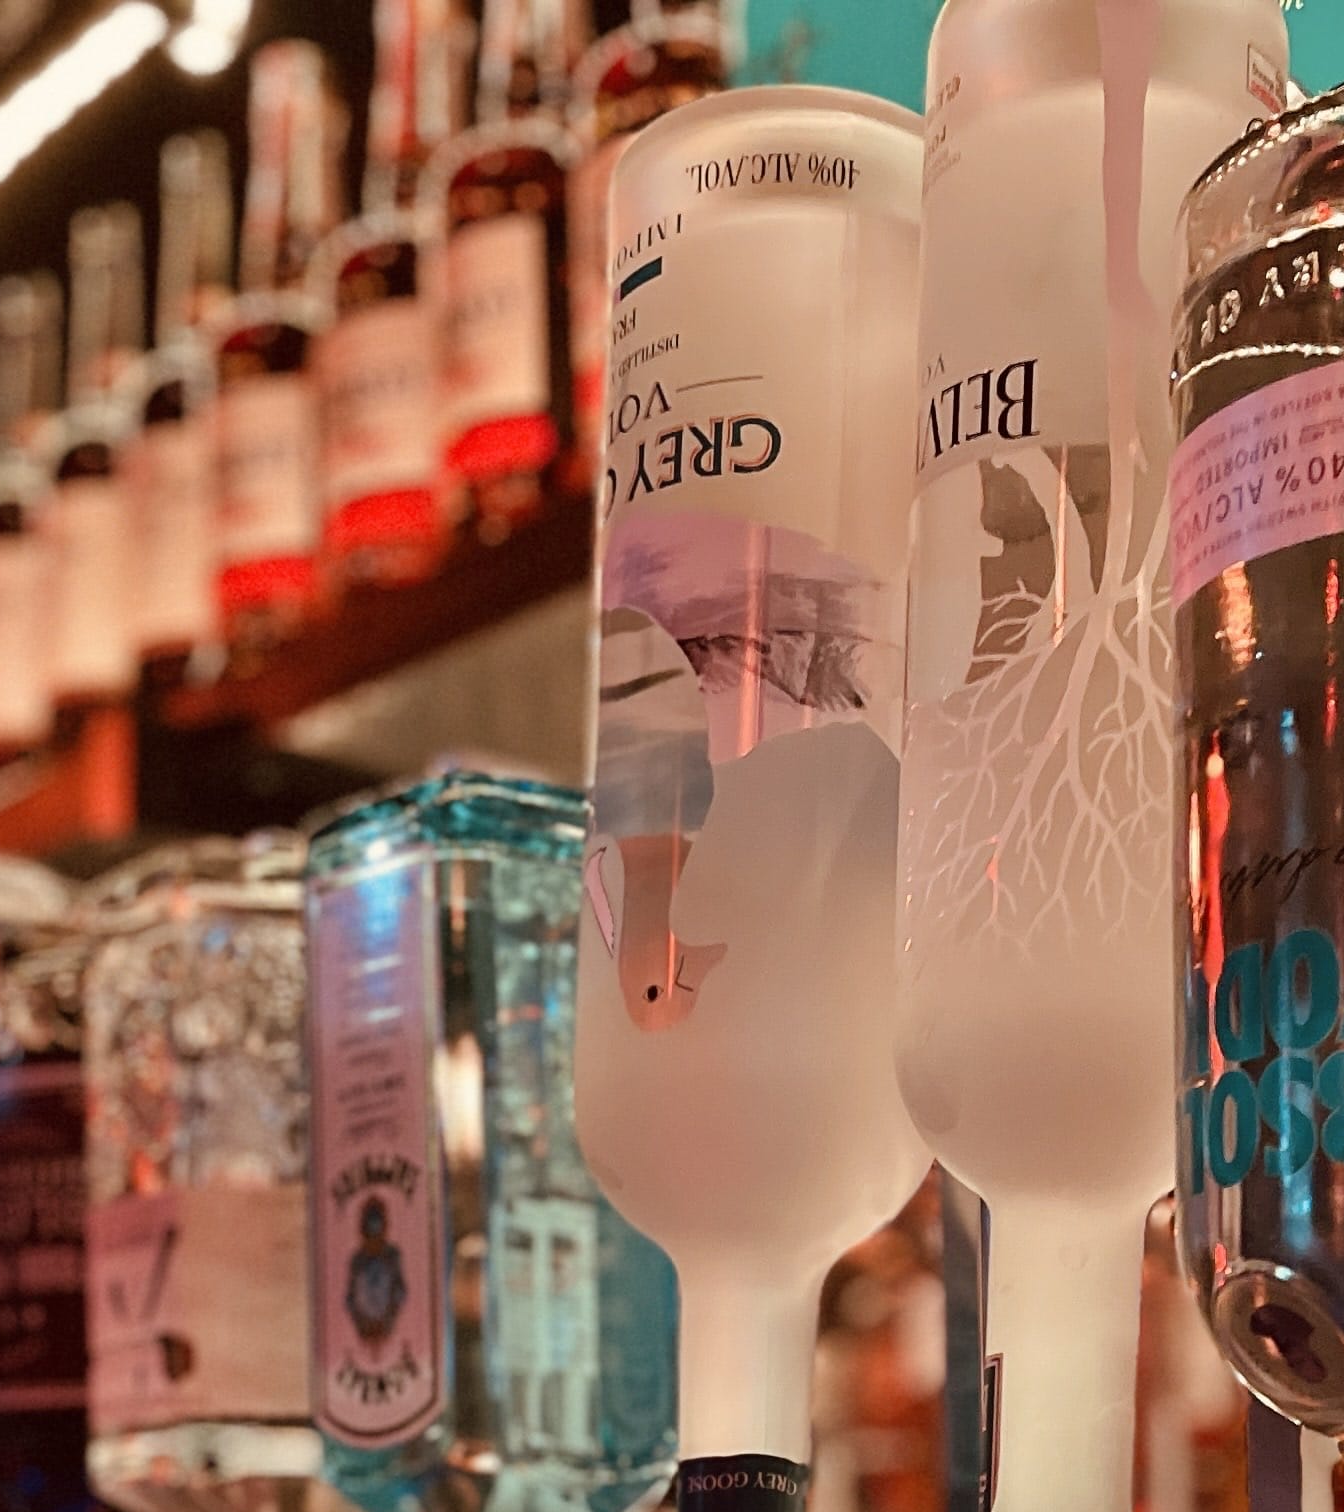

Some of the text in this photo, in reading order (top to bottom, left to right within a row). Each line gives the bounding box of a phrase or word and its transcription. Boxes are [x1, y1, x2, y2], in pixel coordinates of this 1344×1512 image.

[624, 415, 782, 504] GREY
[1195, 430, 1289, 496] IMPORTED
[686, 1470, 798, 1496] GREY GOOSE
